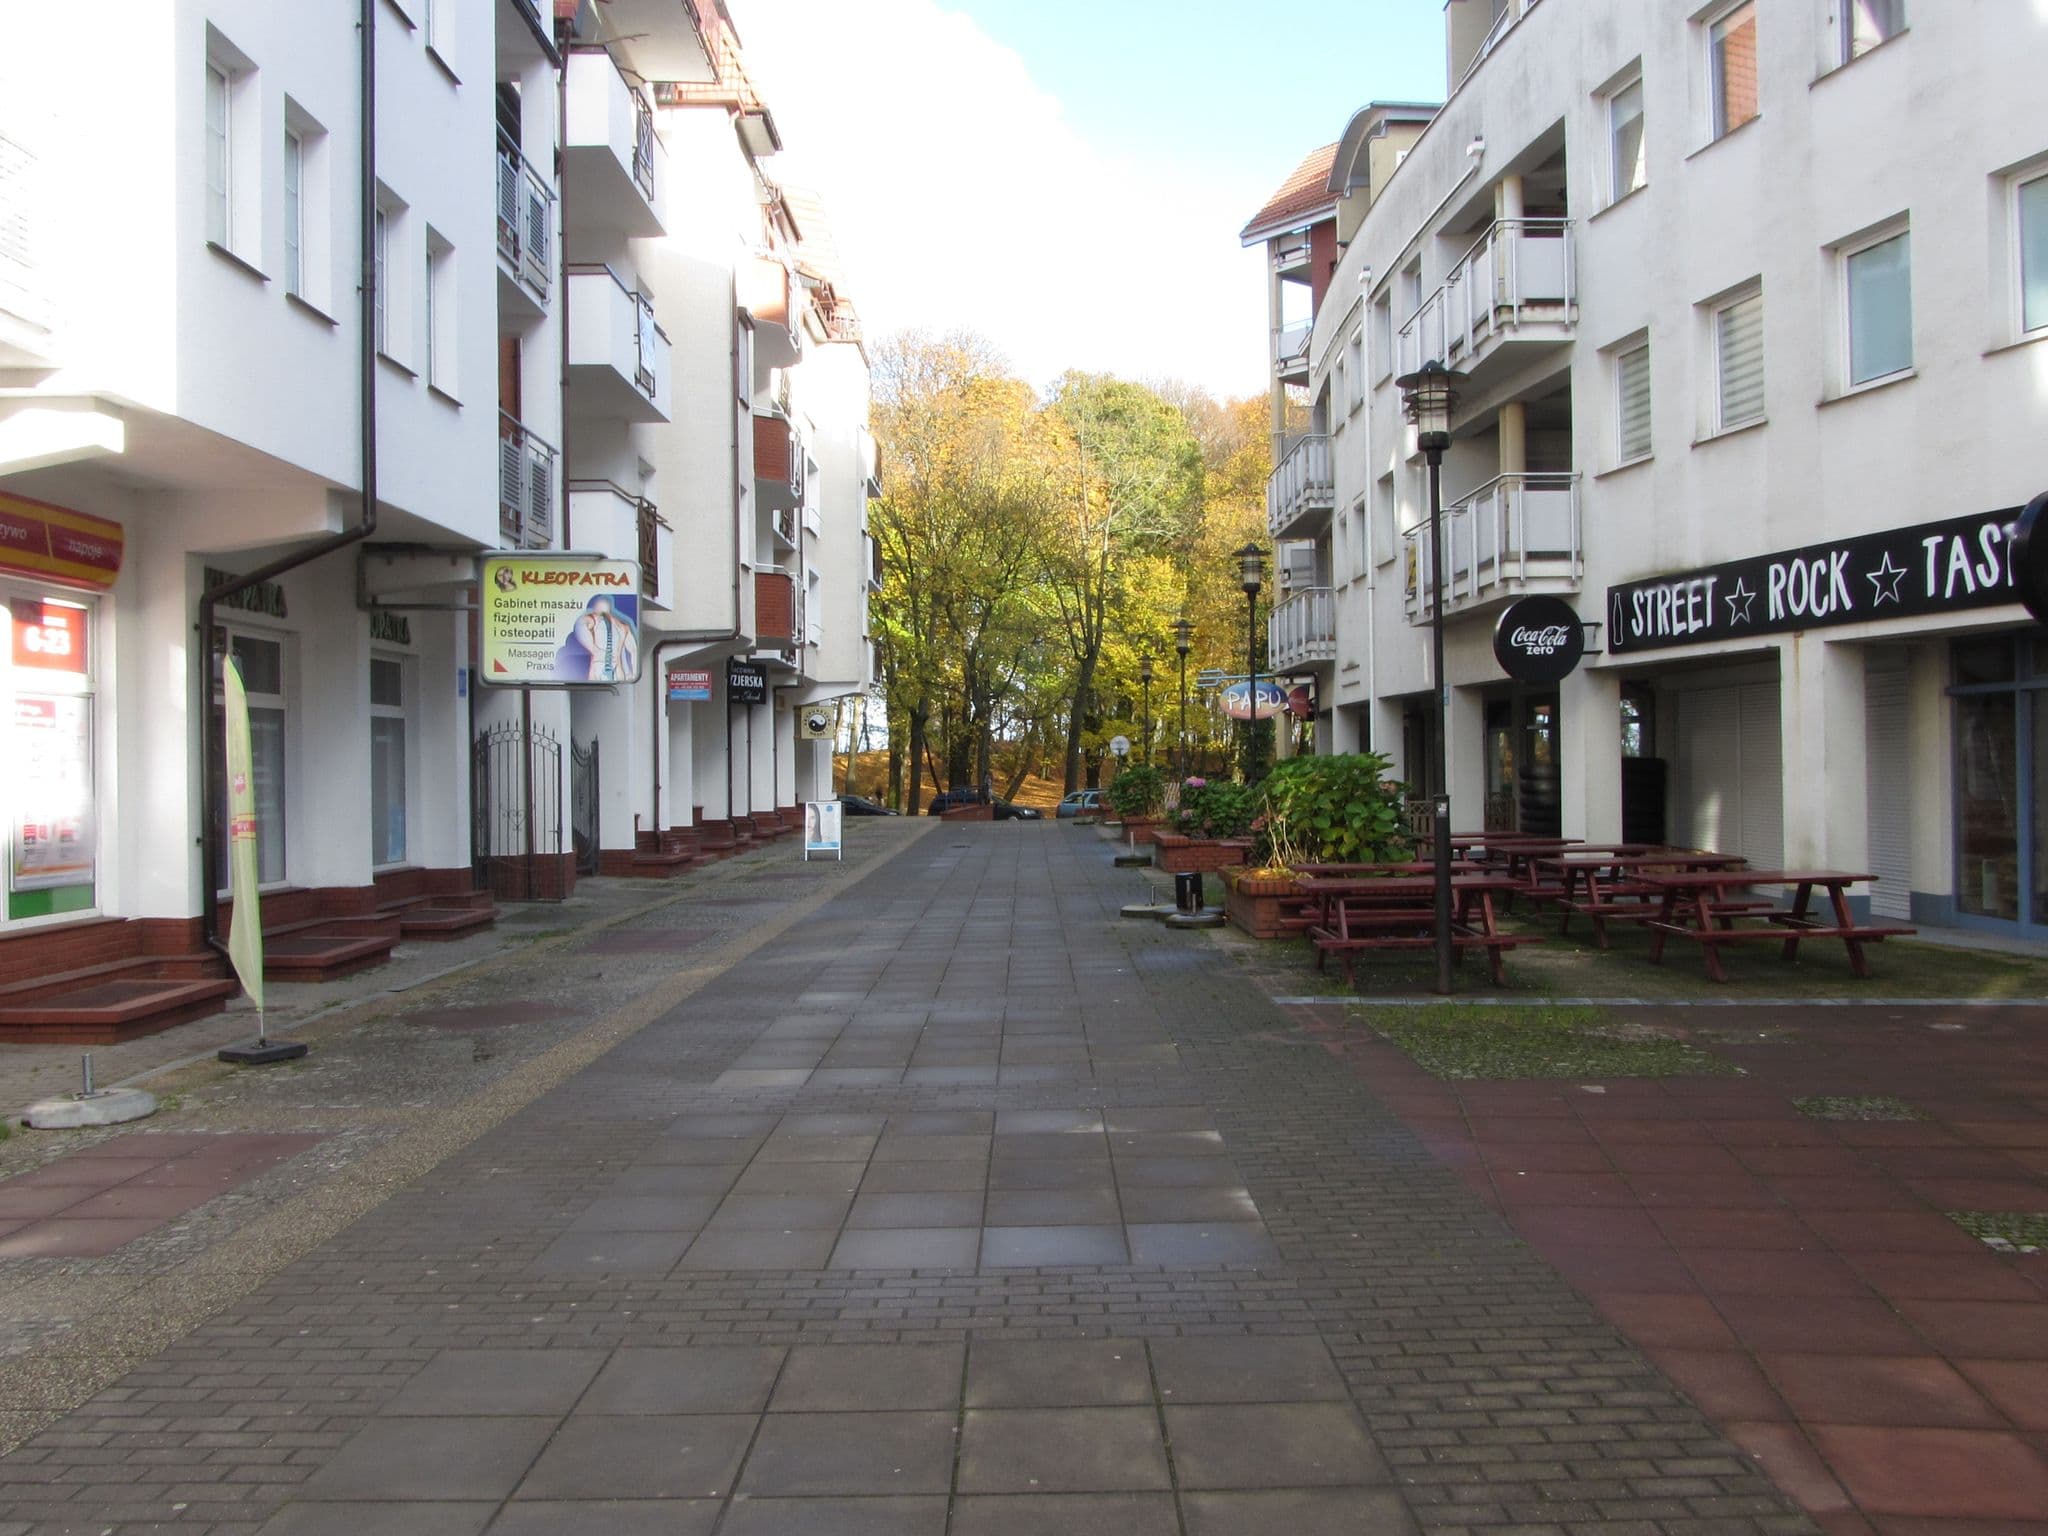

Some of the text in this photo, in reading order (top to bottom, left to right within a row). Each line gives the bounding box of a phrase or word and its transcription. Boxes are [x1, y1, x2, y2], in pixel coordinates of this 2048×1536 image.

[68, 538, 103, 558] napoje
[521, 571, 630, 586] KLEOPATRA
[1631, 576, 1718, 637] STREET
[1769, 551, 1852, 621] ROCK
[494, 598, 583, 610] Gabinet masażu
[494, 613, 555, 625] fizjoterapii
[493, 628, 555, 640] i osteopatii
[1511, 625, 1570, 647] Coca-Cola
[508, 649, 554, 661] Massagen
[1526, 646, 1554, 655] zero
[526, 662, 554, 671] Praxis
[670, 673, 708, 682] APARTAMENTY
[1227, 690, 1281, 711] PAPU
